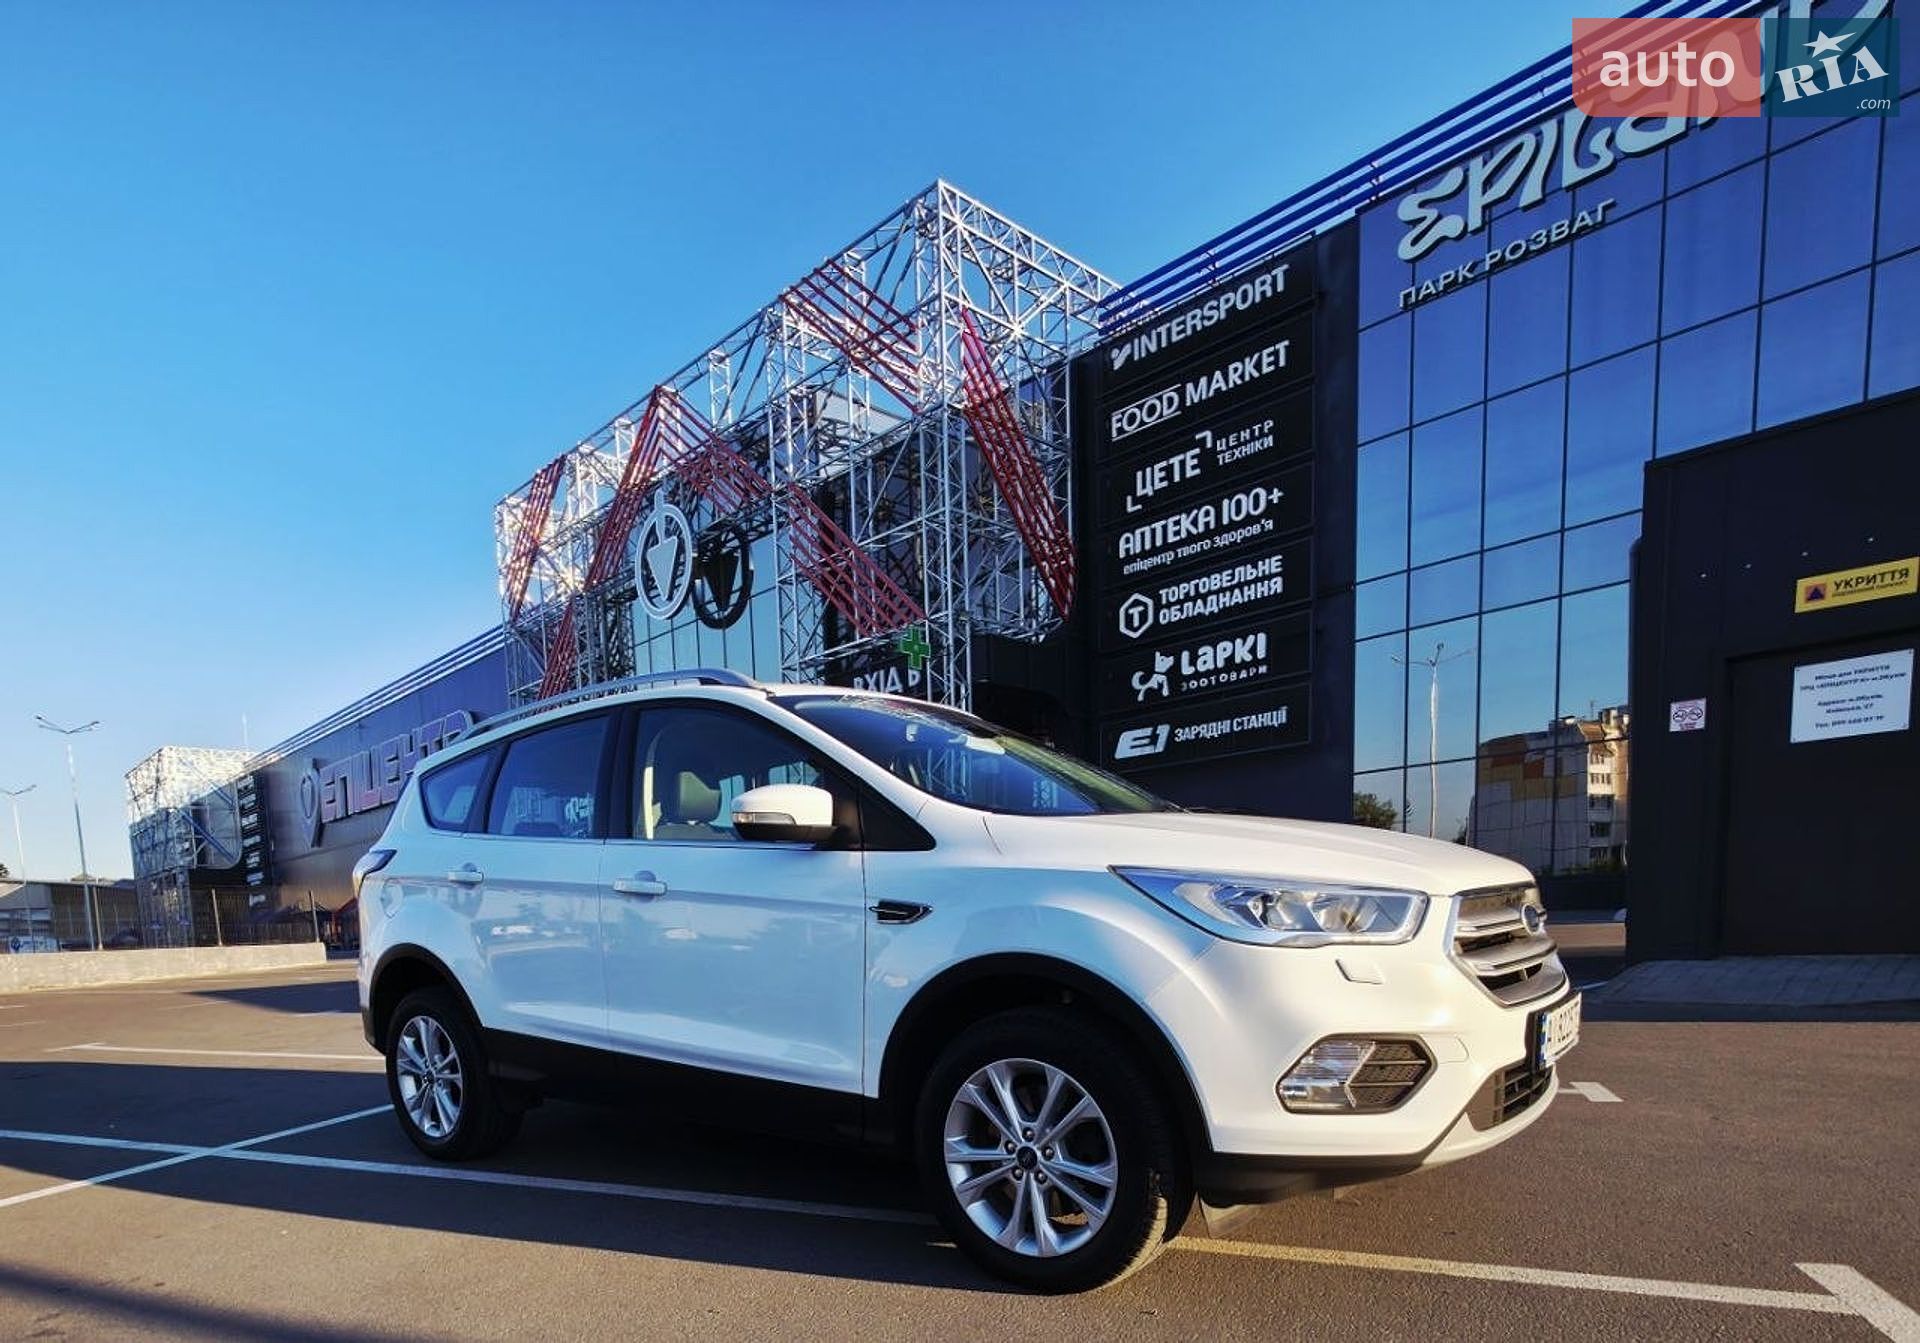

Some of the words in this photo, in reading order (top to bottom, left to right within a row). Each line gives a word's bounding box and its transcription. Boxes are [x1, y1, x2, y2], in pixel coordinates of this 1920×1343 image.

[1399, 262, 1475, 308] ПАРК
[1484, 198, 1615, 272] РОЗВАГ
[1133, 264, 1290, 361] INTERSPORT
[1111, 390, 1179, 438] FOOD
[1185, 340, 1290, 407] MARKET
[1216, 419, 1274, 451] ЦЕНТР
[1217, 435, 1274, 466] ТЕХНІКИ
[1136, 447, 1201, 497] ЦЕТЕ
[1118, 505, 1216, 559] АПТЕКА
[1222, 487, 1284, 525] 100+
[1123, 549, 1175, 575] епіцентр
[1177, 539, 1211, 559] твого
[1159, 554, 1283, 605] ТОРГОВЕЛЬНЕ
[1834, 567, 1909, 591] УКРИТТЯ
[1159, 576, 1283, 625] ОБЛАДНАННЯ
[1174, 719, 1231, 743] ЗАРЯДНІ
[1232, 706, 1288, 731] СТАНЦІЇ
